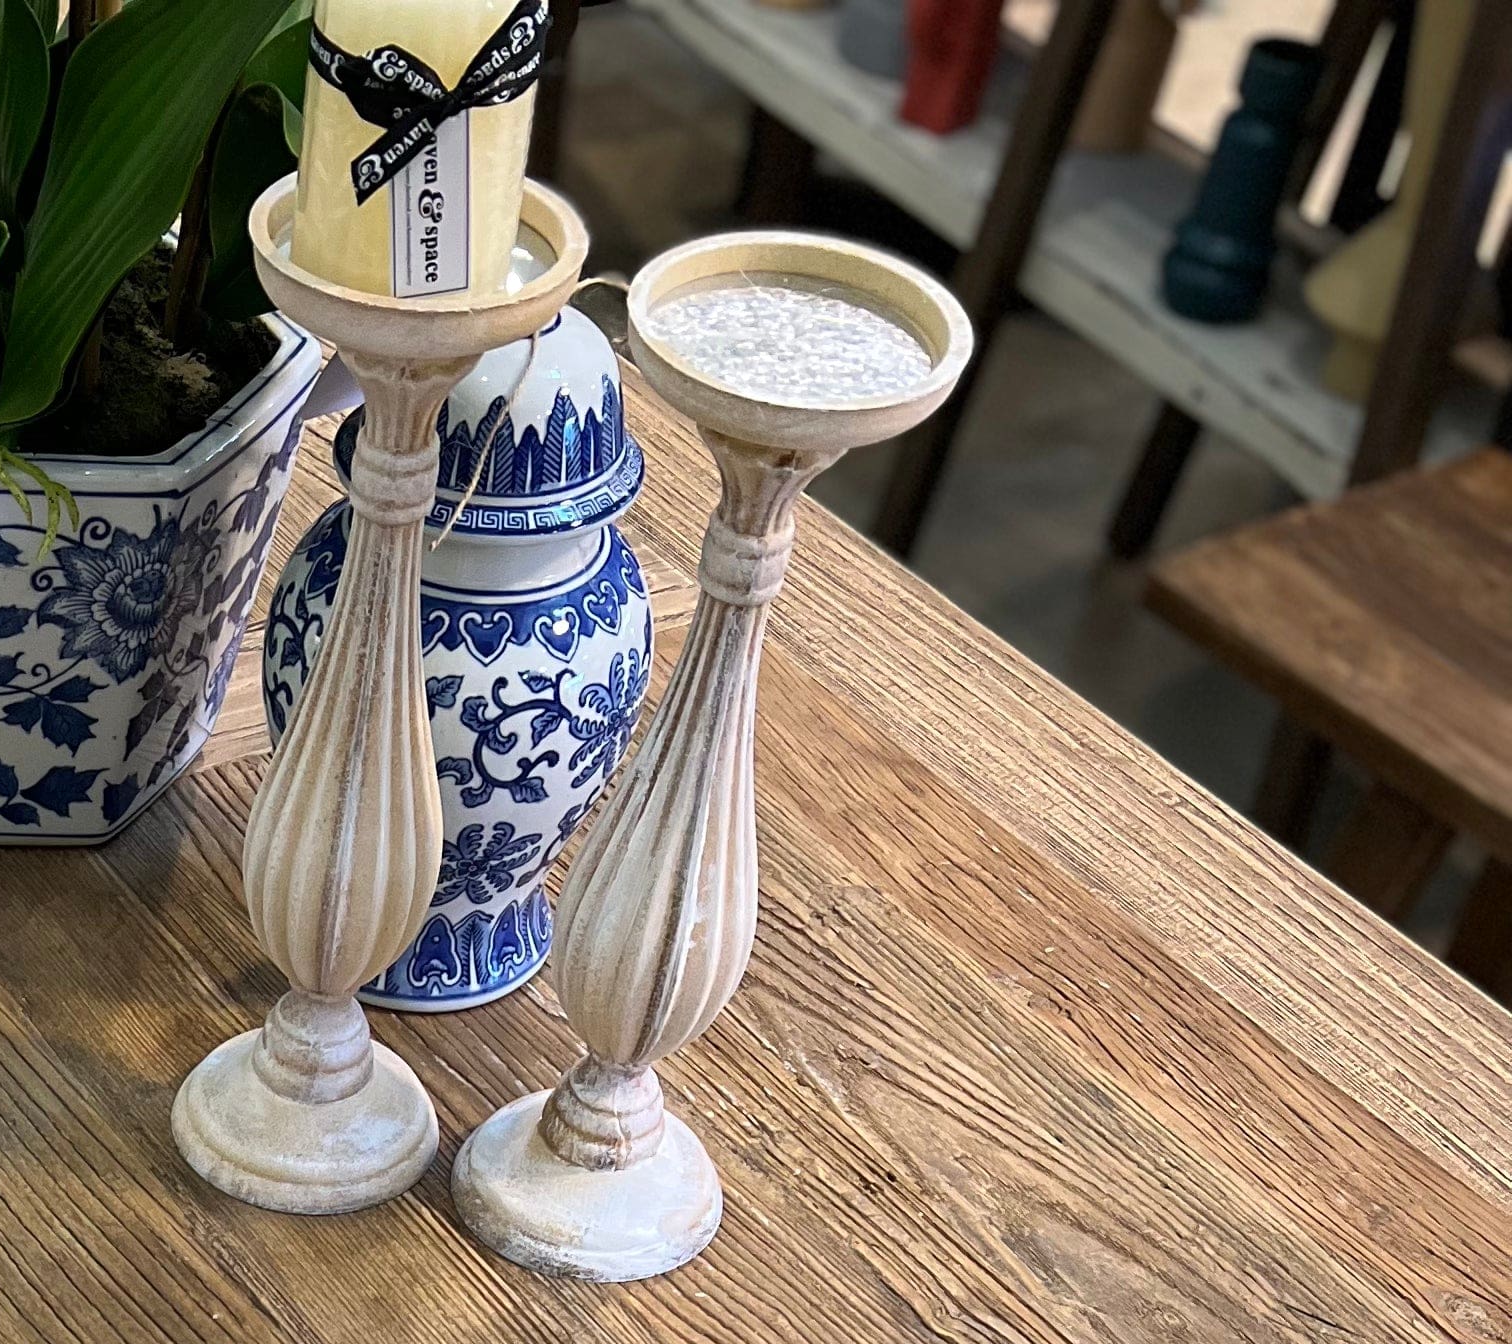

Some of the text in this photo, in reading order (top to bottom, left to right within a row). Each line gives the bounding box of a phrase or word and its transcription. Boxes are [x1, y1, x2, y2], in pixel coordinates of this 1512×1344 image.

[372, 50, 408, 81] &
[384, 118, 434, 164] haven
[418, 142, 444, 283] ven & space
